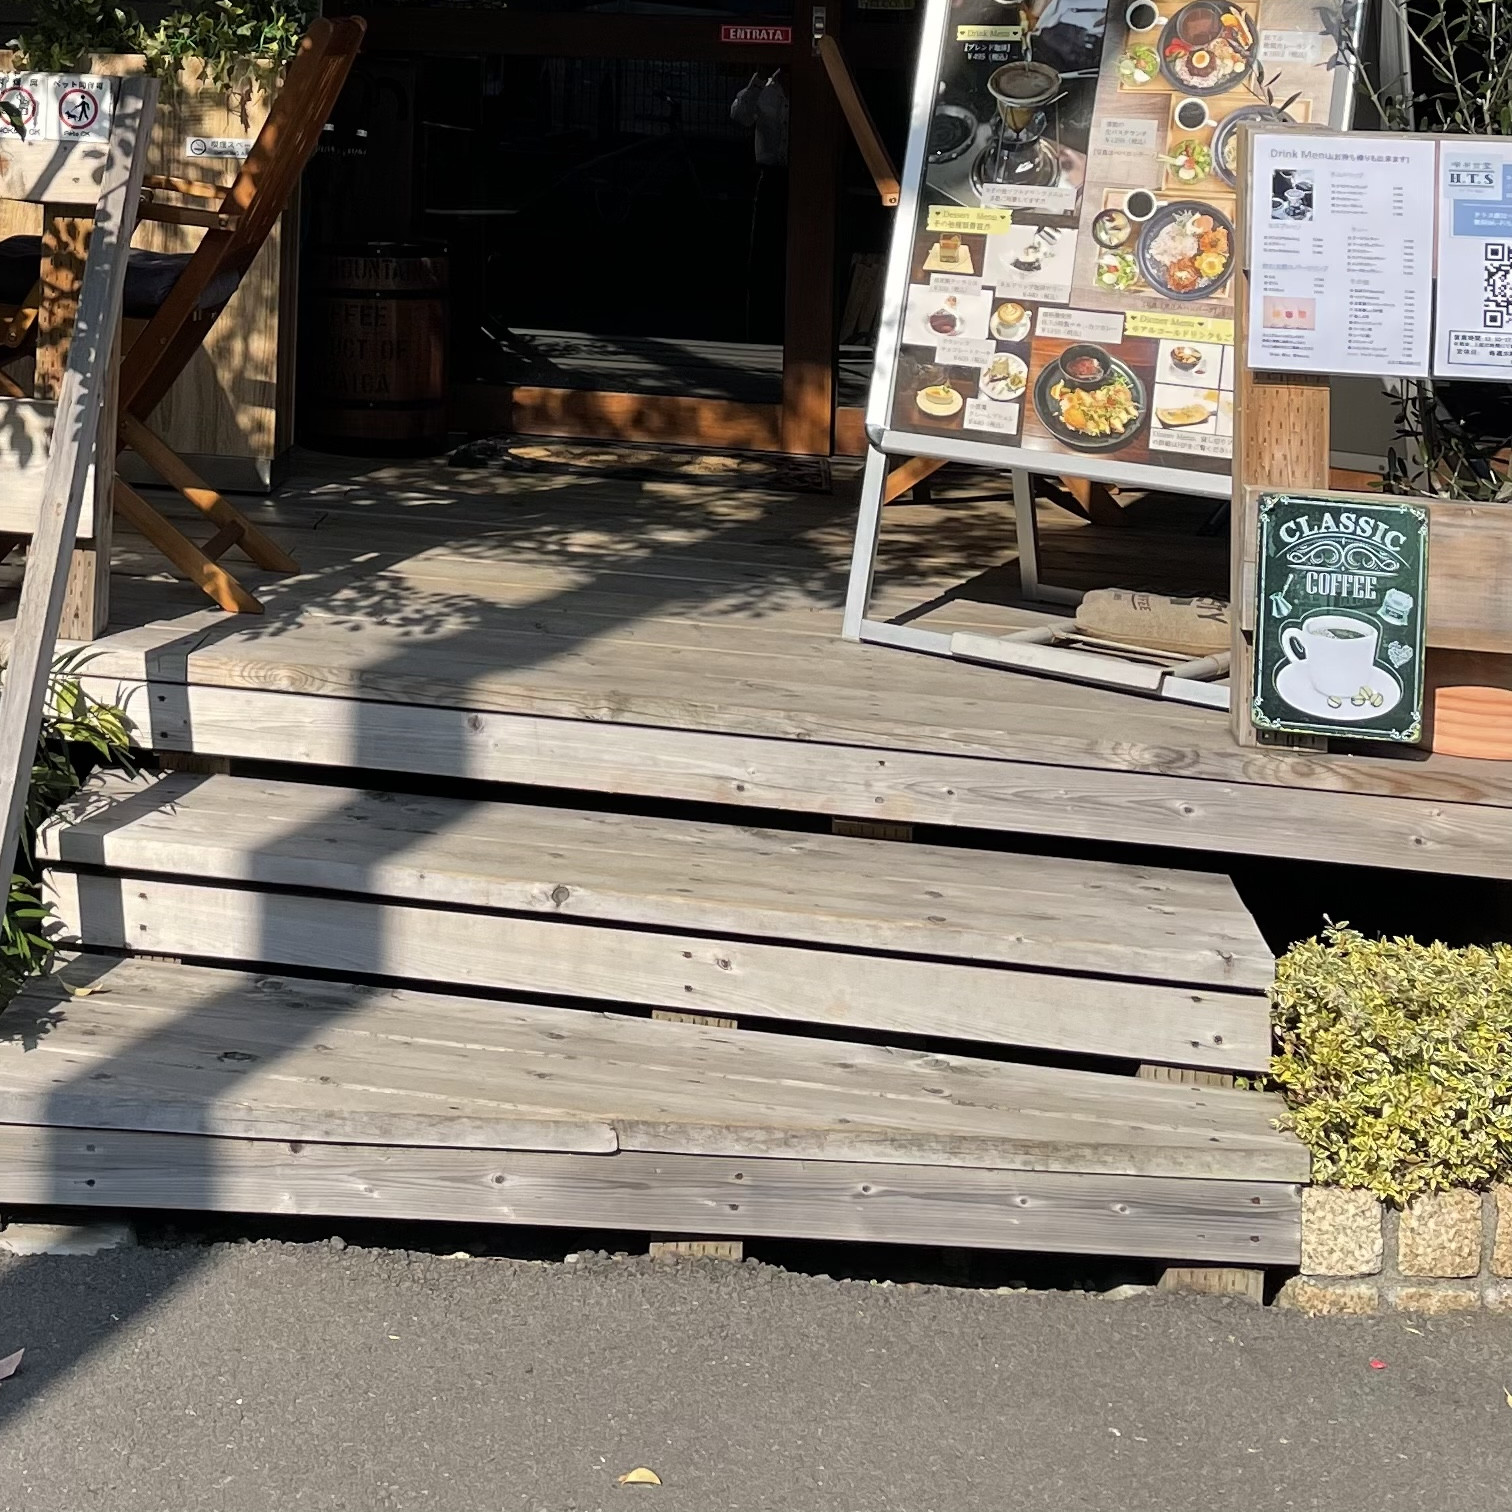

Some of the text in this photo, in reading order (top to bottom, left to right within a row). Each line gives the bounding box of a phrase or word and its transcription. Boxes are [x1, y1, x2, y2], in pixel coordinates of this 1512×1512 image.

[729, 28, 783, 41] ENTRATA
[1270, 148, 1298, 158] Drink
[1450, 173, 1494, 185] H.T.S
[1278, 512, 1408, 552] CLASSIC
[1305, 570, 1378, 601] COFFEE
